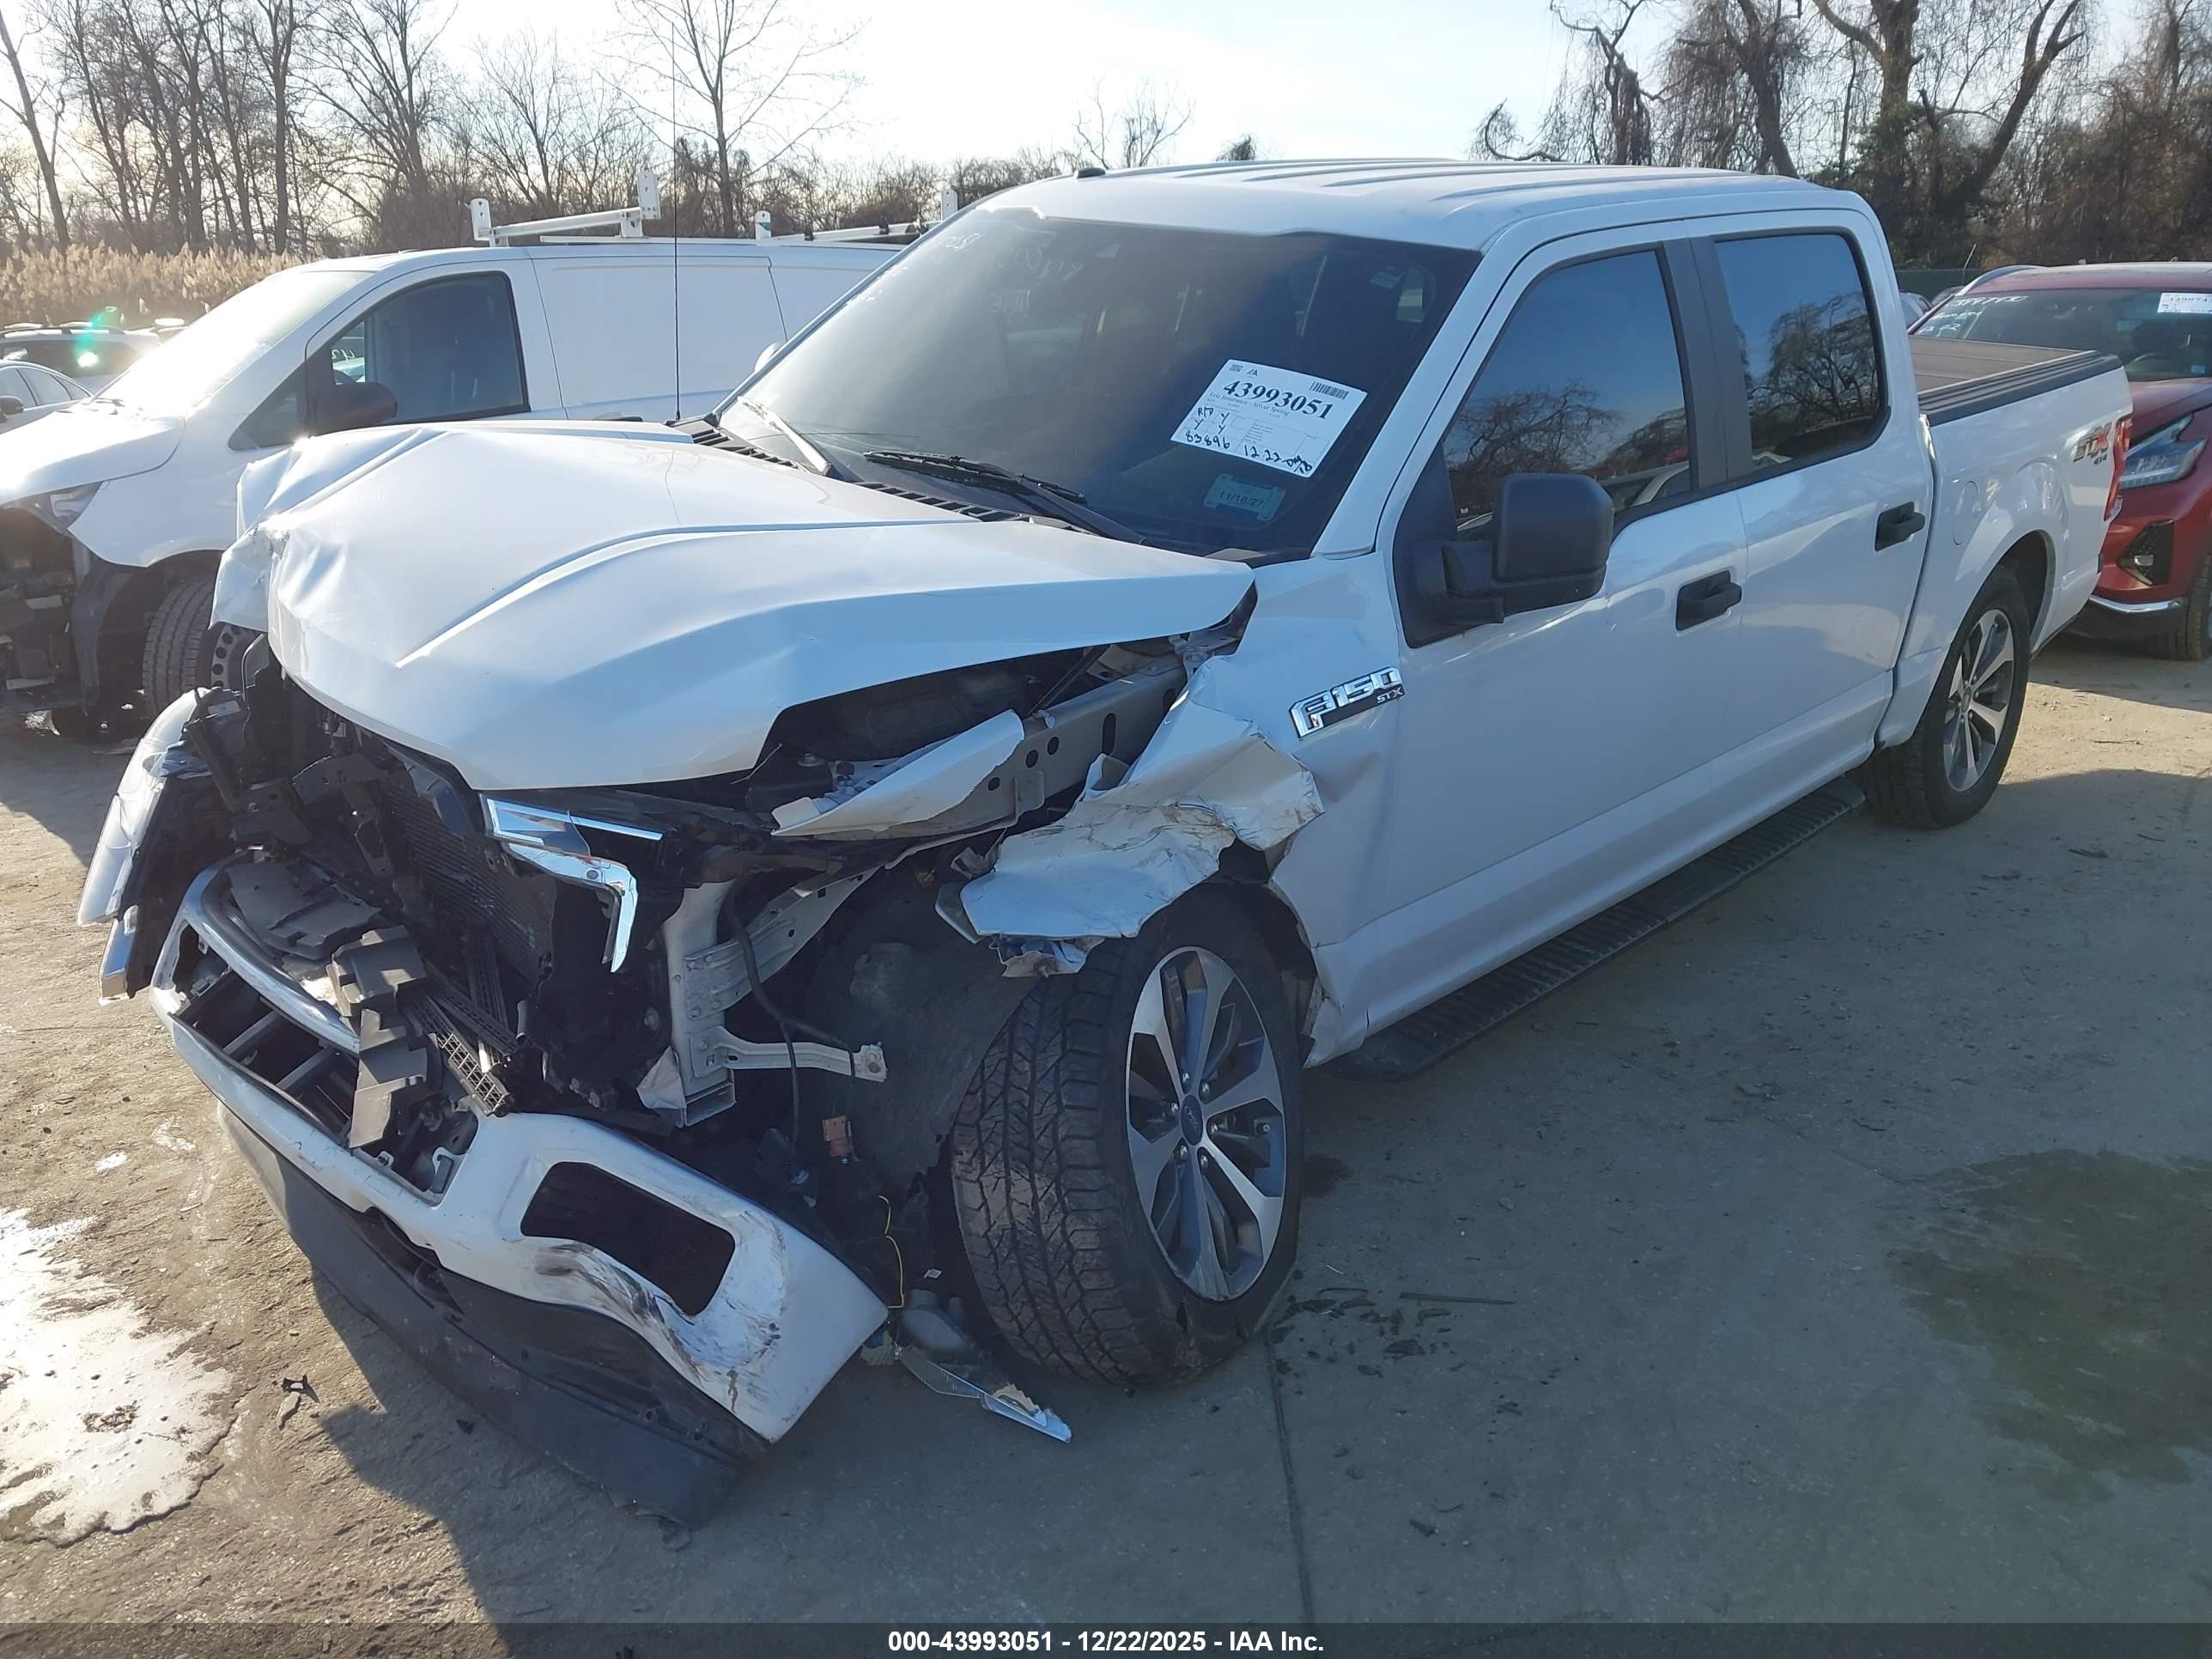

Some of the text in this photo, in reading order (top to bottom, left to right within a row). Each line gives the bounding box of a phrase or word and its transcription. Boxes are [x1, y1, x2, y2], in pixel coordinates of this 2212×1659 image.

[1223, 380, 1334, 420] 43993051
[1186, 431, 1231, 449] 83896
[1376, 686, 1404, 703] STX
